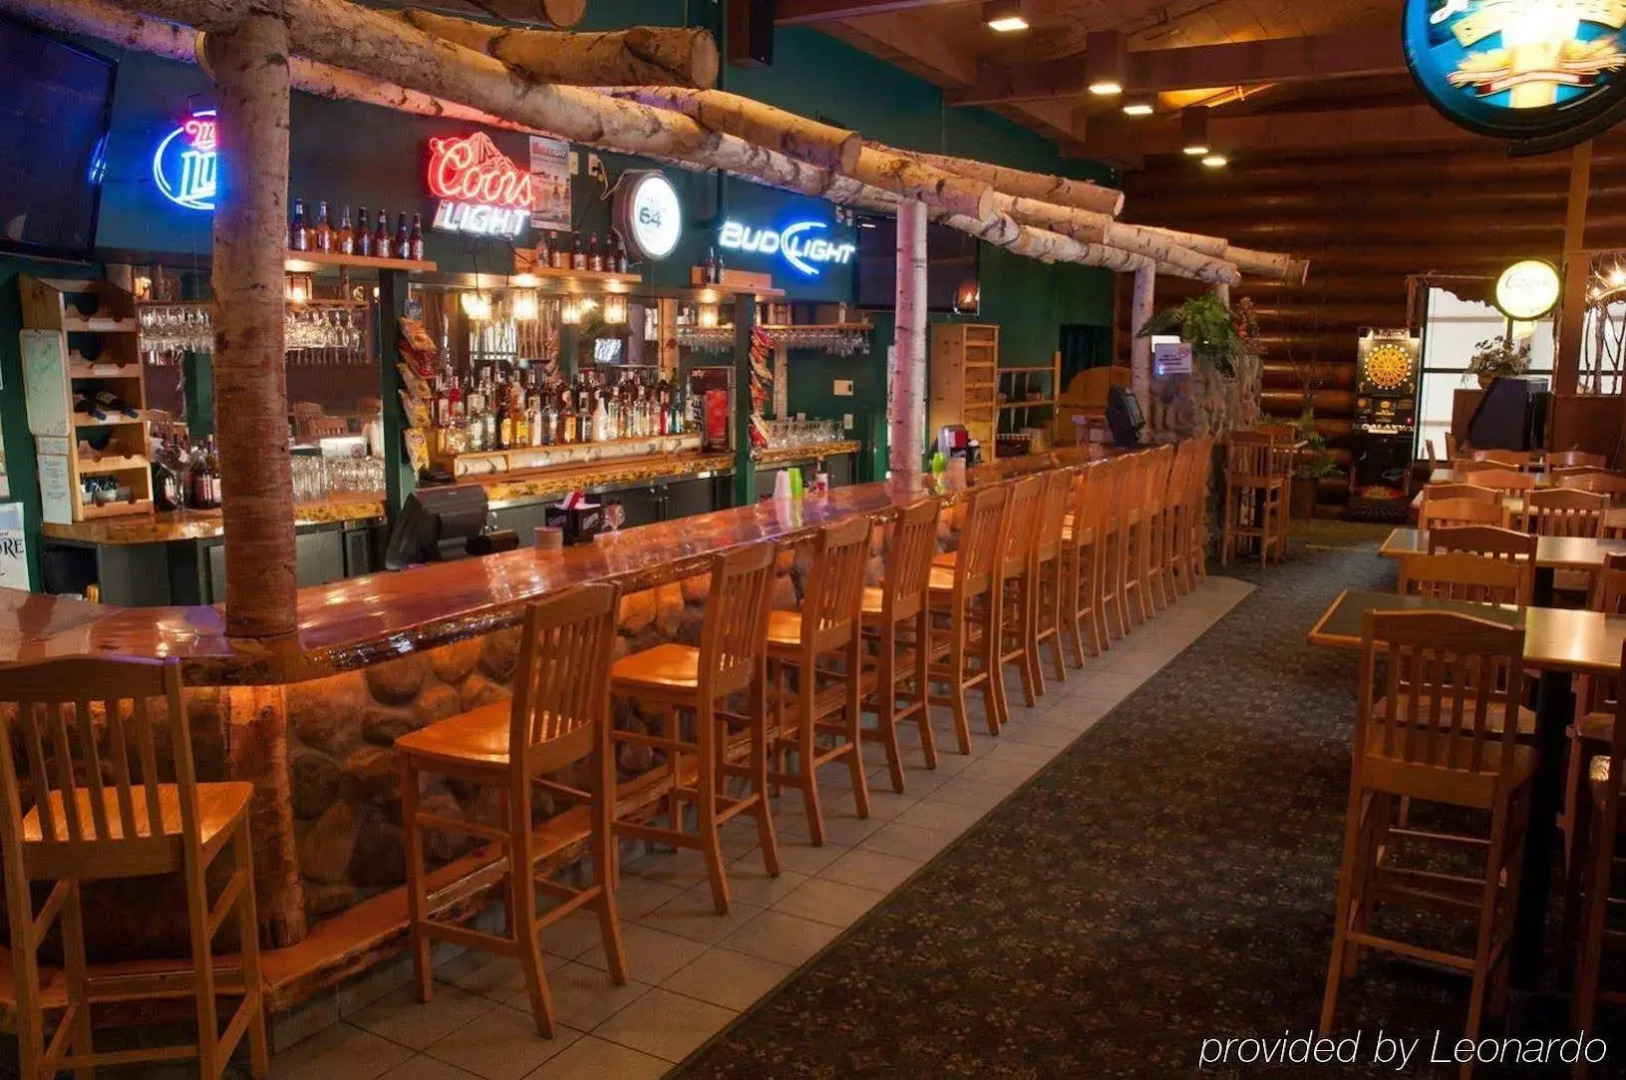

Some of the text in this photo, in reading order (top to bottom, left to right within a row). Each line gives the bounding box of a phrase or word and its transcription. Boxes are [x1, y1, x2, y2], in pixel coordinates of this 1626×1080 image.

[429, 137, 536, 207] Coors
[442, 202, 531, 235] LIGHT
[639, 206, 662, 228] 64
[790, 236, 856, 264] LIGHT
